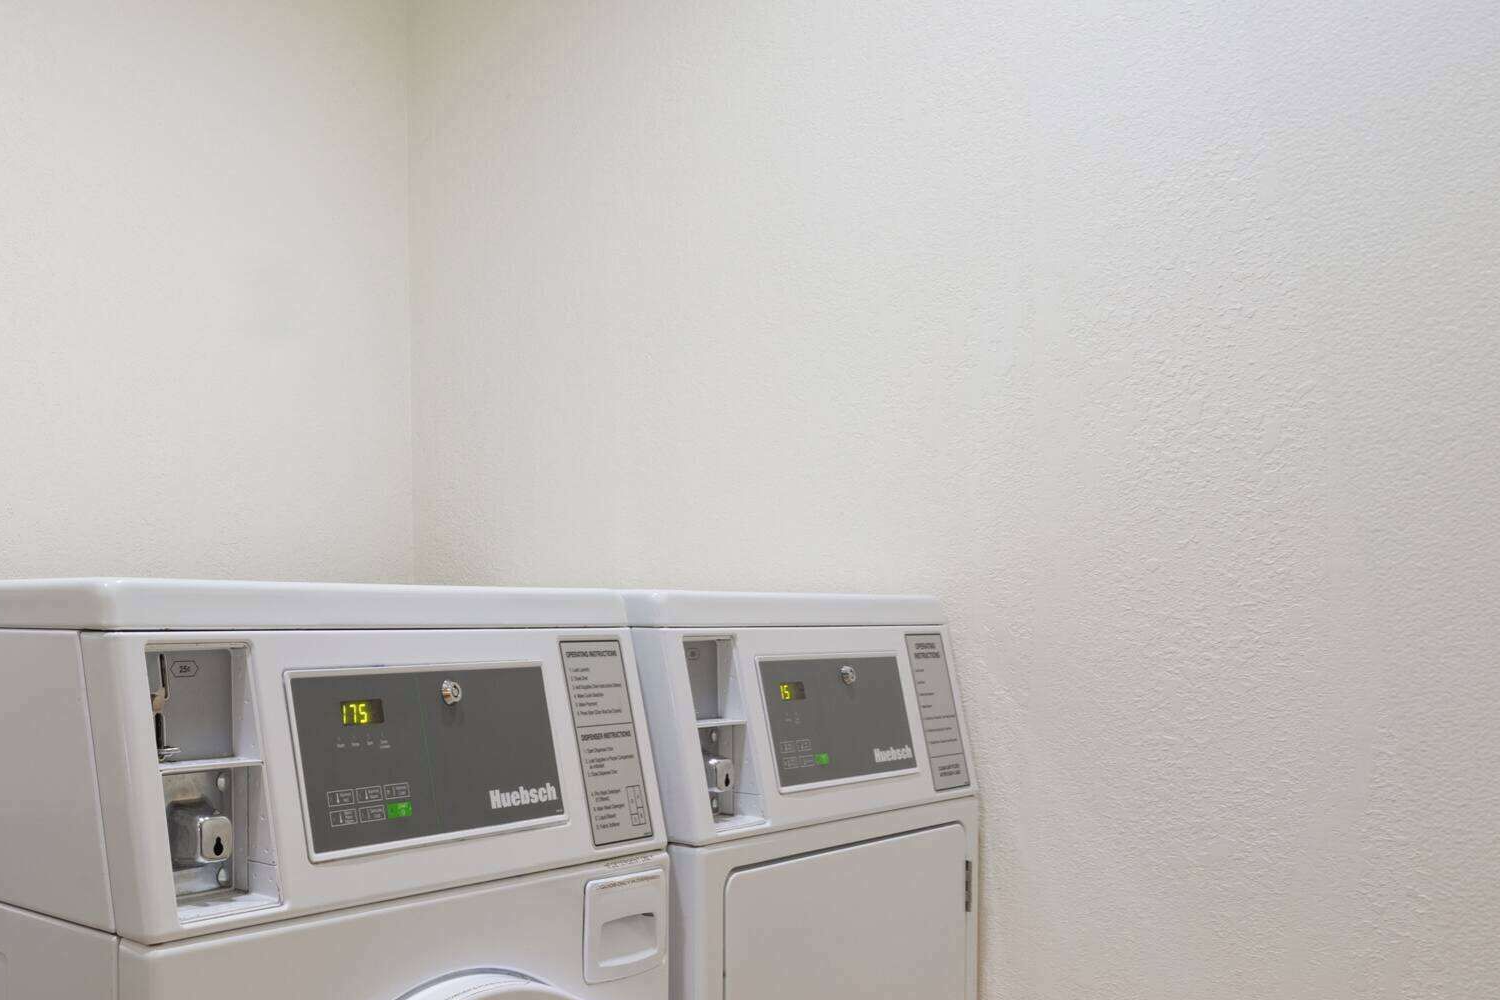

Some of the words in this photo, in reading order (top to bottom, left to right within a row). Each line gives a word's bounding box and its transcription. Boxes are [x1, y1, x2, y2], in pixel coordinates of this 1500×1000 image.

[779, 684, 791, 700] 15
[342, 703, 368, 725] 175
[873, 744, 913, 763] Huebsch
[488, 782, 558, 810] Huebsch
